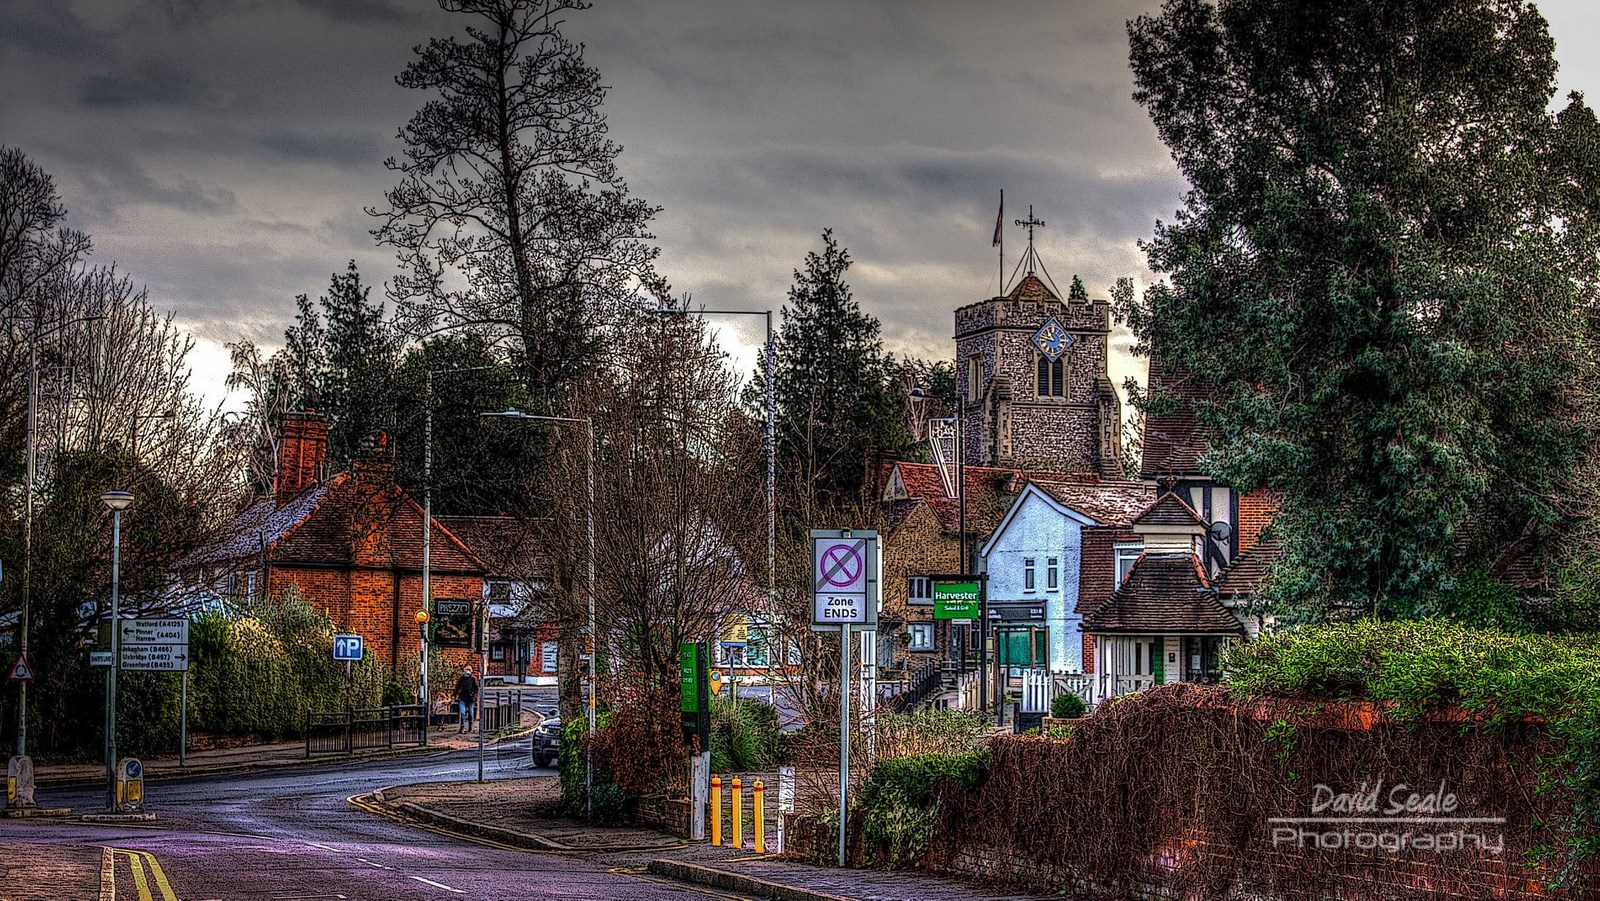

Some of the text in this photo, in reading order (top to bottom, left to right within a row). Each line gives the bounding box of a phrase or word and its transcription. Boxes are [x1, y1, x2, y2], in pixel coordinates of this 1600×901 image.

[935, 592, 977, 600] Harvester
[828, 597, 853, 606] Zone
[824, 608, 858, 618] ENDS
[346, 638, 360, 656] P
